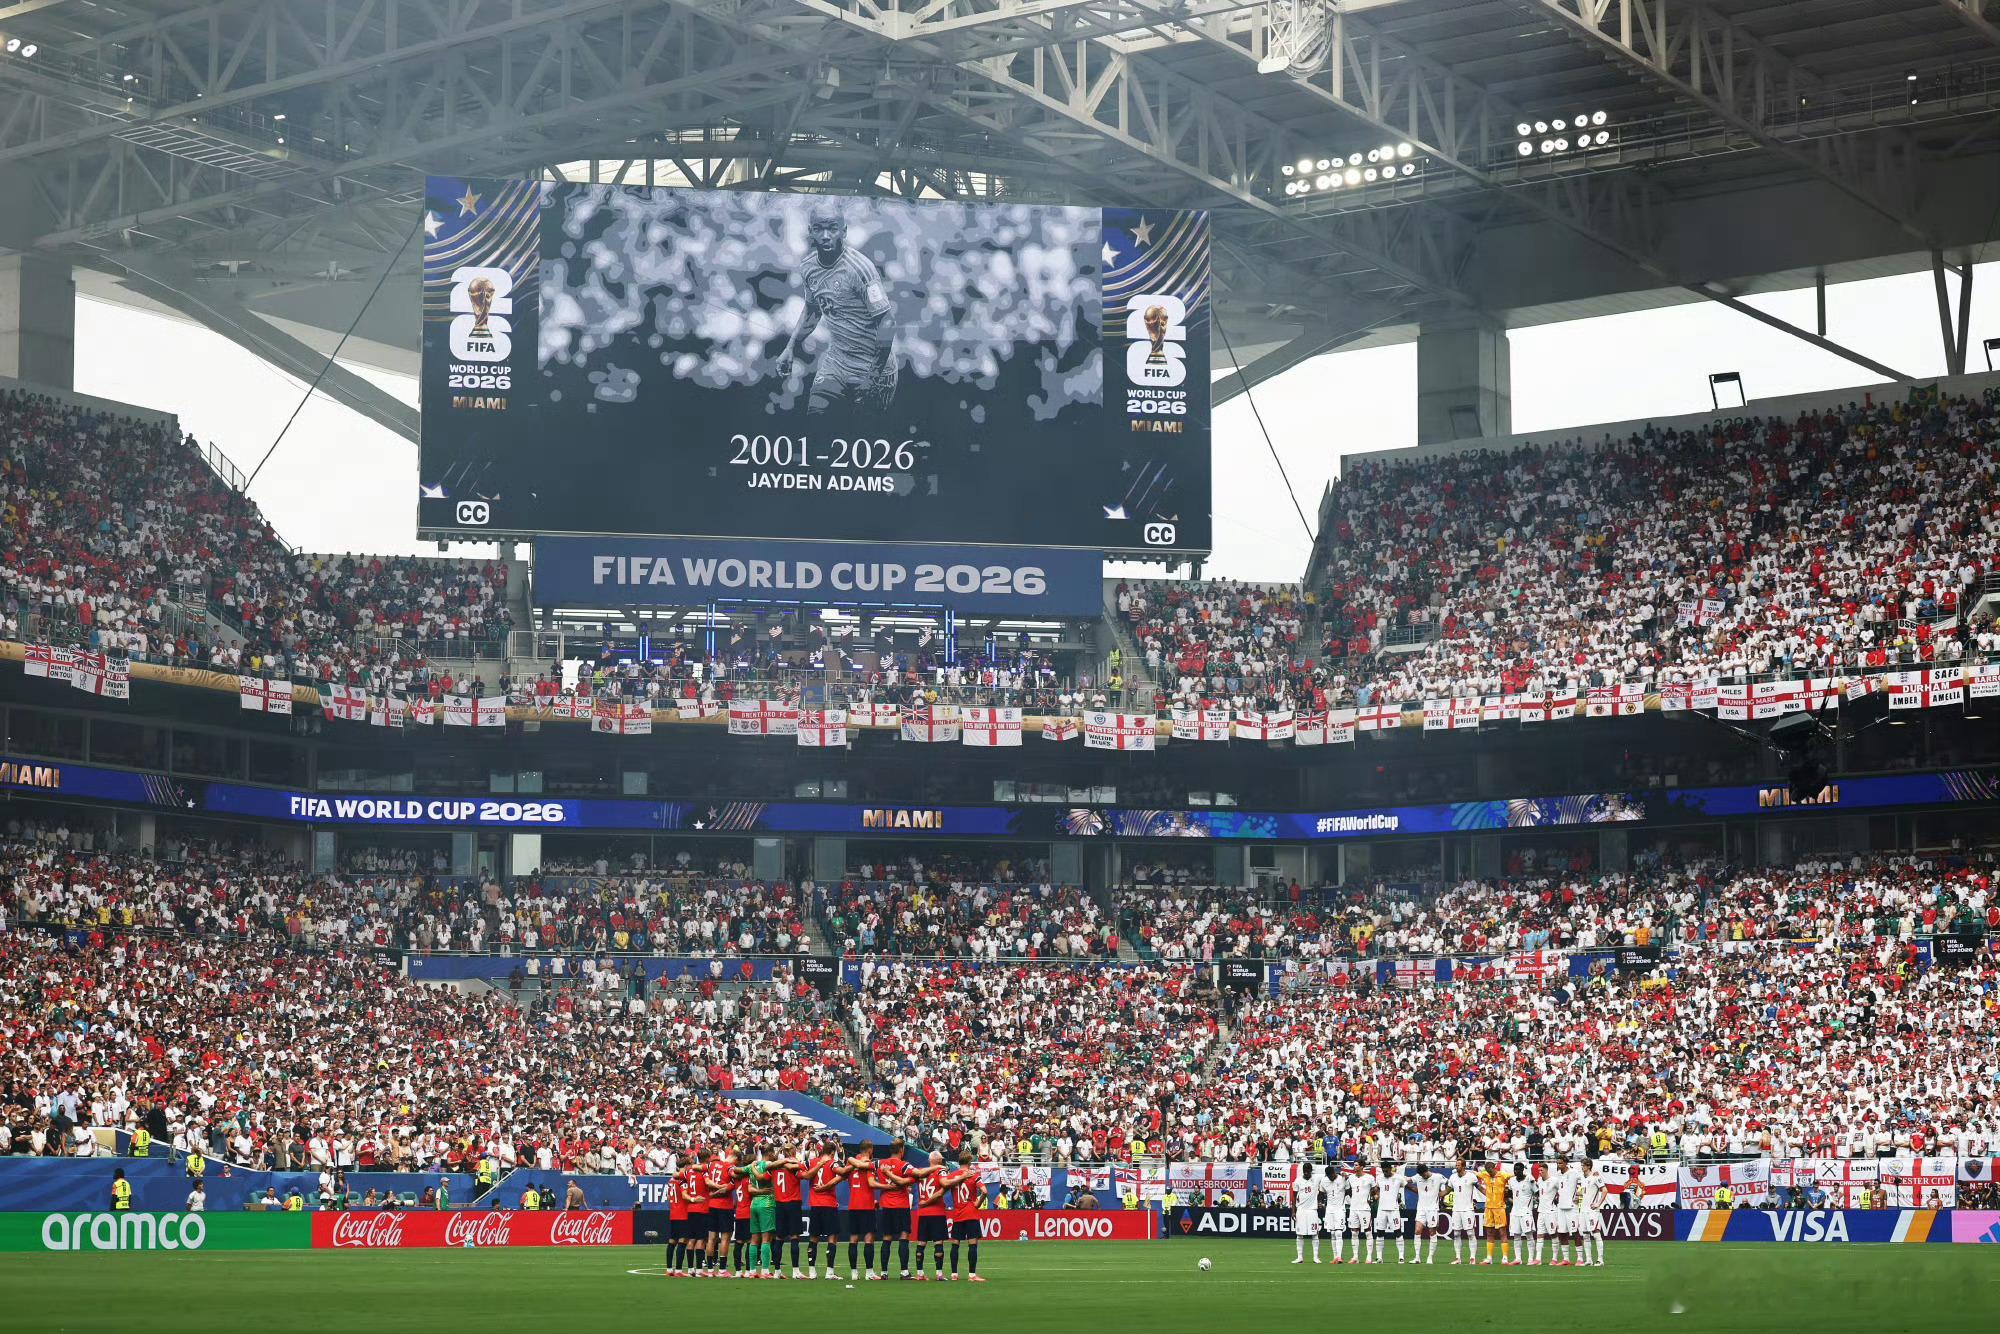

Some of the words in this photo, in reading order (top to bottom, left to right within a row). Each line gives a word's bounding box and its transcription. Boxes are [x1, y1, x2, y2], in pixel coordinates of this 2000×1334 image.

[466, 341, 496, 353] FIFA
[448, 364, 488, 375] WORLD
[489, 365, 512, 375] CUP
[1144, 368, 1171, 378] FIFA
[448, 374, 512, 389] 2026
[1126, 389, 1165, 399] WORLD
[1166, 390, 1187, 400] CUP
[452, 396, 507, 410] MIAMI
[1126, 400, 1187, 414] 2026
[1131, 419, 1184, 433] MIAMI
[729, 434, 914, 470] 2001-2026
[747, 472, 822, 491] JAYDEN
[827, 475, 895, 493] ADAMS
[458, 504, 487, 522] CC
[1146, 526, 1173, 542] CC
[593, 555, 676, 586] FIFA
[678, 557, 822, 589] WORLD
[831, 562, 907, 591] CUP
[914, 564, 1047, 596] 2026
[1934, 668, 1959, 680] SAFC
[1902, 681, 1950, 693] DURHAM
[1532, 690, 1567, 699] WOVES
[1793, 691, 1824, 700] RAUNDS
[1893, 696, 1918, 705] AMBER
[1932, 691, 1961, 703] AMELIA
[1427, 709, 1463, 717] ARSENAL
[1086, 726, 1142, 736] PORTSMOUTH
[1143, 728, 1154, 736] FC
[291, 796, 332, 818] FIFA
[335, 799, 423, 820] WORLD
[428, 801, 475, 820] CUP
[480, 802, 564, 822] 2026
[863, 809, 943, 829] MIAMI
[1316, 815, 1399, 832] #FIFAWorldCup
[1264, 1171, 1287, 1179] Mate
[1602, 1165, 1667, 1176] BEECHY'S
[777, 1172, 785, 1193] 9
[1172, 1179, 1245, 1189] MIDDLESBROUGH
[1264, 1181, 1291, 1190] Jimmy
[1931, 1177, 1952, 1185] CITY
[639, 1184, 669, 1203] FIFA
[956, 1183, 969, 1203] 10
[1682, 1183, 1752, 1199] BLACKOOL
[1754, 1181, 1768, 1193] FC
[332, 1211, 407, 1247] Coca-Cola
[445, 1211, 514, 1247] Coca-Cola
[551, 1211, 616, 1245] Coca-Cola
[1034, 1212, 1113, 1238] Lenovo
[1197, 1213, 1248, 1233] ADI
[1762, 1210, 1850, 1242] VISA
[42, 1213, 206, 1250] aramco
